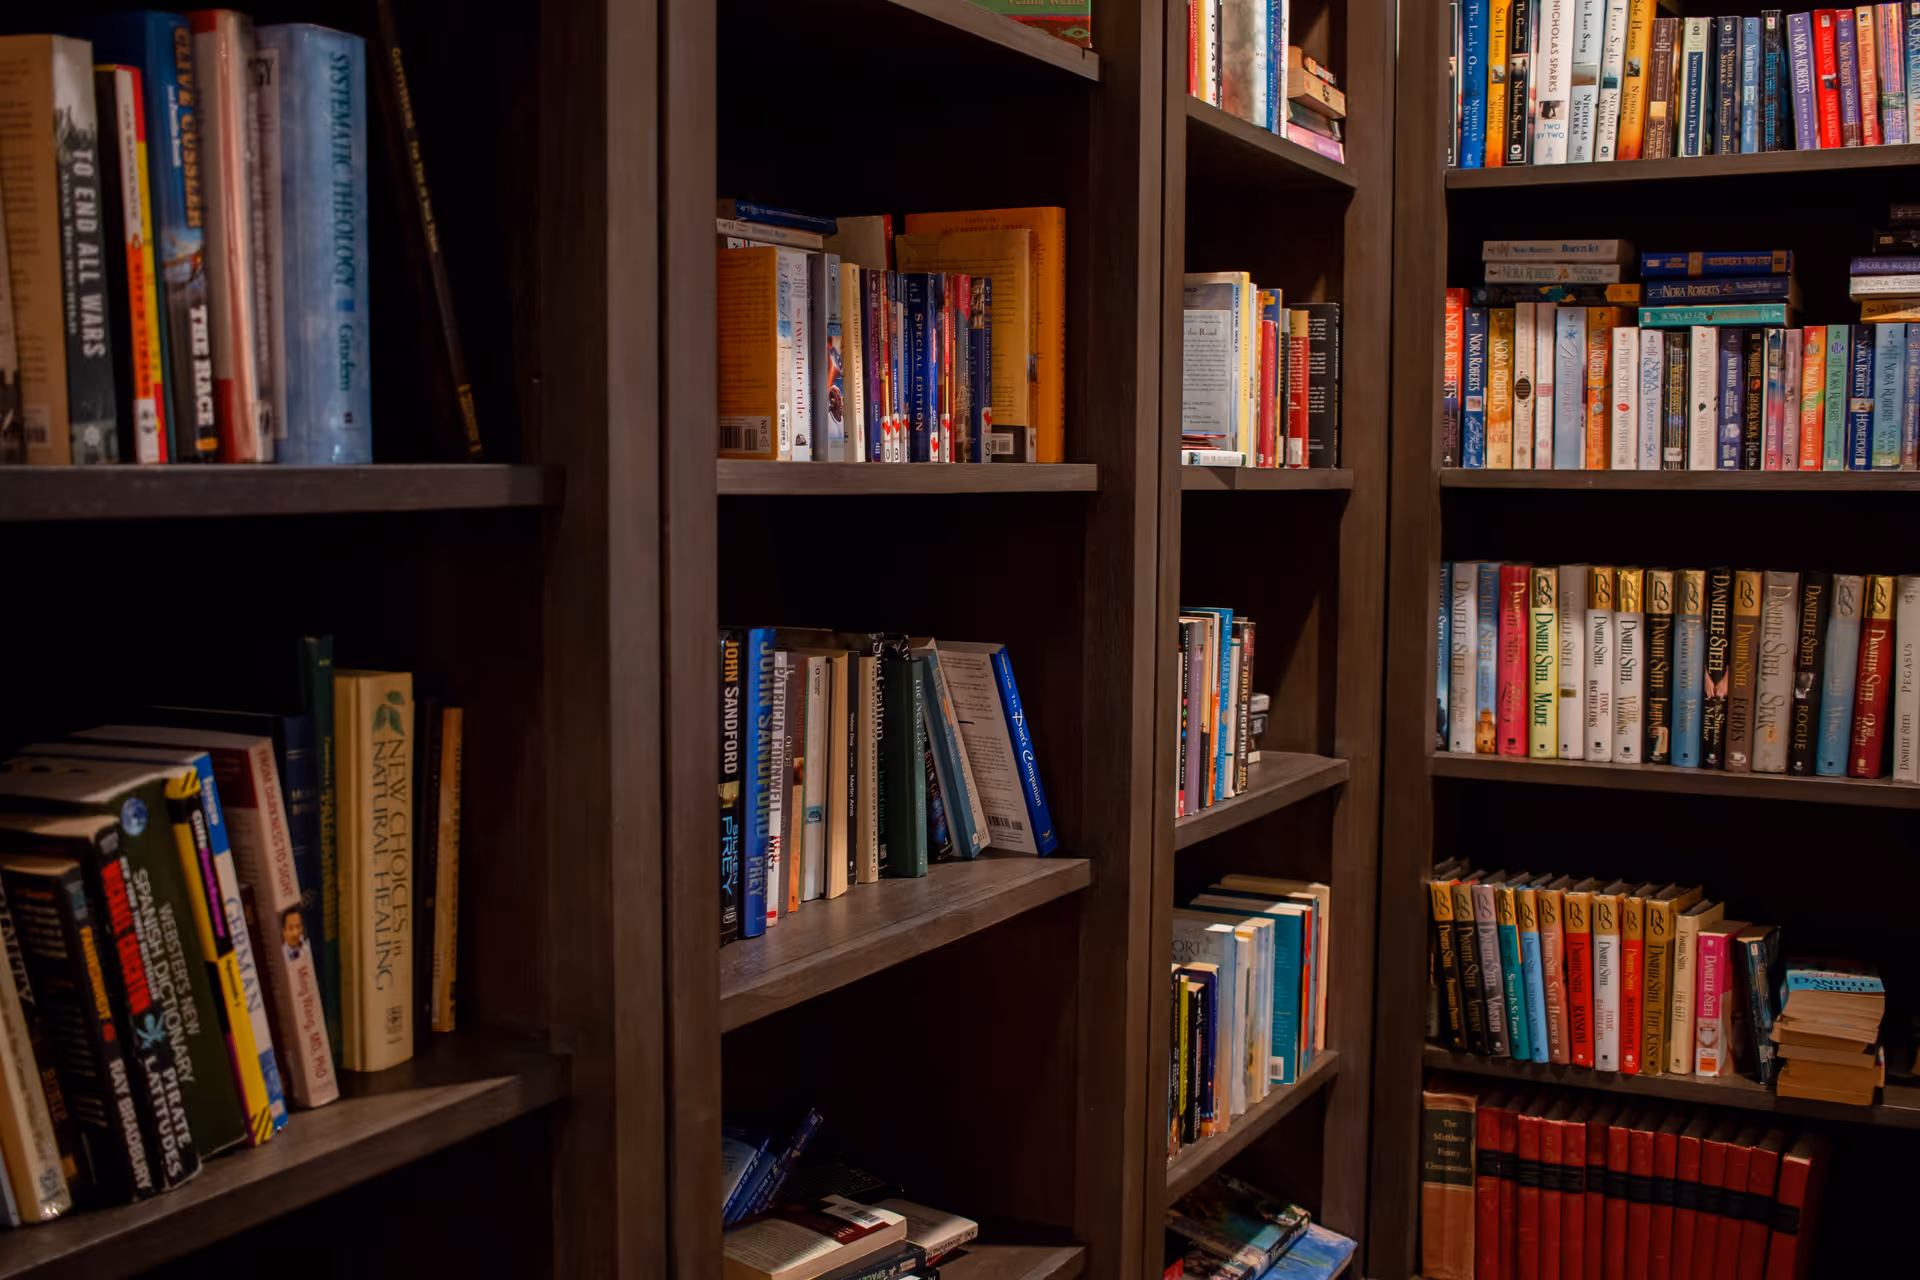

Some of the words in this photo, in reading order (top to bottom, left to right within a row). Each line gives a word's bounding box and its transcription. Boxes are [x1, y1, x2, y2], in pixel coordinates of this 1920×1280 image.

[1468, 3, 1478, 22] The
[1515, 1, 1525, 16] The
[1549, 0, 1561, 55] NICHOLAS
[1583, 13, 1592, 31] Last
[1467, 24, 1478, 52] Lucky
[1494, 30, 1504, 58] Haven
[1514, 17, 1525, 49] Guardian
[1580, 33, 1592, 54] Song
[1607, 36, 1620, 64] Sight
[1630, 20, 1642, 50] Haven
[1793, 33, 1807, 57] NORA
[174, 27, 194, 107] CLIVE
[1467, 56, 1478, 76] One
[1548, 58, 1558, 93] SPARKS
[1690, 54, 1699, 86] NICHOLAS
[1794, 59, 1810, 94] ROBERTS
[329, 51, 355, 174] SYSTEMATIC
[1513, 80, 1524, 113] Nicholas
[1689, 87, 1698, 113] SPARKS
[1464, 105, 1472, 137] SPARKS
[1470, 99, 1480, 142] NICHOLAS
[1511, 114, 1523, 139] Sparks
[1572, 100, 1582, 135] SPARKS
[1580, 93, 1592, 141] NICHOLAS
[1607, 93, 1618, 141] NICHOLAS
[72, 149, 95, 177] TO
[180, 113, 204, 228] CUSSLER
[75, 187, 98, 234] END
[332, 179, 357, 289] THEOLOGY
[77, 242, 101, 285] ALL
[1662, 285, 1685, 298] NORA
[1687, 284, 1720, 297] ROBERTS
[80, 293, 106, 358] WARS
[190, 304, 210, 355] THE
[914, 313, 923, 370] SPECIAL
[1445, 313, 1458, 349] NORA
[1469, 333, 1483, 357] NORA
[338, 323, 357, 392] Grudem
[795, 320, 806, 386] two-date
[194, 358, 215, 426] RACE
[1443, 351, 1458, 399] ROBERTS
[1469, 358, 1482, 392] ROBERTS
[1883, 362, 1897, 386] NORA
[796, 388, 807, 420] rule
[915, 375, 924, 433] EDITION
[1881, 388, 1896, 422] ROBERTS
[760, 419, 768, 436] EAN
[1855, 413, 1869, 459] HOMEPORT
[1453, 580, 1471, 639] DANIELLE
[1711, 575, 1730, 634] DANIELLE
[1764, 585, 1793, 638] DANIELLE
[1802, 585, 1822, 635] DANIELLE
[1534, 612, 1554, 653] DANIELLE
[1800, 635, 1818, 669] STEEL
[724, 639, 739, 682] JOHN
[759, 640, 774, 707] JOHN
[872, 641, 885, 675] Sue
[1452, 642, 1470, 676] STEEL
[1534, 653, 1554, 685] STEEL
[1708, 636, 1728, 674] STEEL
[1760, 639, 1789, 682] STEEL
[1900, 643, 1913, 693] PEGASUS
[771, 665, 786, 732] PATRICIA
[1241, 664, 1249, 702] ZODIAC
[876, 675, 885, 741] Grafton
[915, 701, 924, 726] Next
[1534, 692, 1553, 727] MALICE
[1588, 679, 1599, 728] BACHELORS
[1600, 691, 1609, 716] TOXIC
[1616, 695, 1637, 735] WEDDING
[1714, 713, 1725, 733] Sins
[1731, 696, 1749, 742] ECHOES
[1756, 692, 1786, 731] STAR
[723, 686, 739, 775] SANDFORD
[1239, 703, 1248, 760] DECEPTION
[1703, 705, 1715, 742] Mother
[1793, 704, 1809, 750] ROGUE
[258, 749, 275, 784] FROM
[386, 738, 406, 806] NEW
[755, 714, 772, 840] SANDFORD
[768, 737, 784, 812] CORNWELL
[1022, 749, 1042, 807] Companion
[264, 785, 285, 845] DARKNESS
[372, 741, 390, 863] NATURAL
[275, 845, 287, 862] TO
[388, 811, 410, 935] CHOICES
[721, 815, 733, 896] PREY
[278, 862, 294, 898] SIGHT
[748, 855, 764, 897] PREY
[373, 872, 394, 992] HEALING
[392, 939, 405, 958] in
[132, 867, 164, 957] SPANISH
[152, 959, 194, 1082] DICTIONARY
[158, 902, 192, 995] WEBSTER'S
[178, 997, 201, 1036] NEW
[223, 897, 263, 1015] GERMAN
[296, 965, 312, 997] Ming
[1547, 980, 1559, 1003] SAFE
[1486, 994, 1503, 1033] VANISHED
[1547, 1005, 1561, 1044] HARBOUR
[1572, 1005, 1586, 1044] RANSOM
[1595, 997, 1605, 1041] BACHELORS
[1605, 1010, 1614, 1032] TOXIC
[1647, 1009, 1662, 1029] THE
[1647, 1033, 1661, 1058] KISS
[108, 1058, 129, 1096] RAY
[144, 1055, 183, 1179] LATITUDES
[163, 1066, 192, 1151] PIRATE
[1442, 1119, 1458, 1128] The
[118, 1098, 152, 1190] BRADBURY
